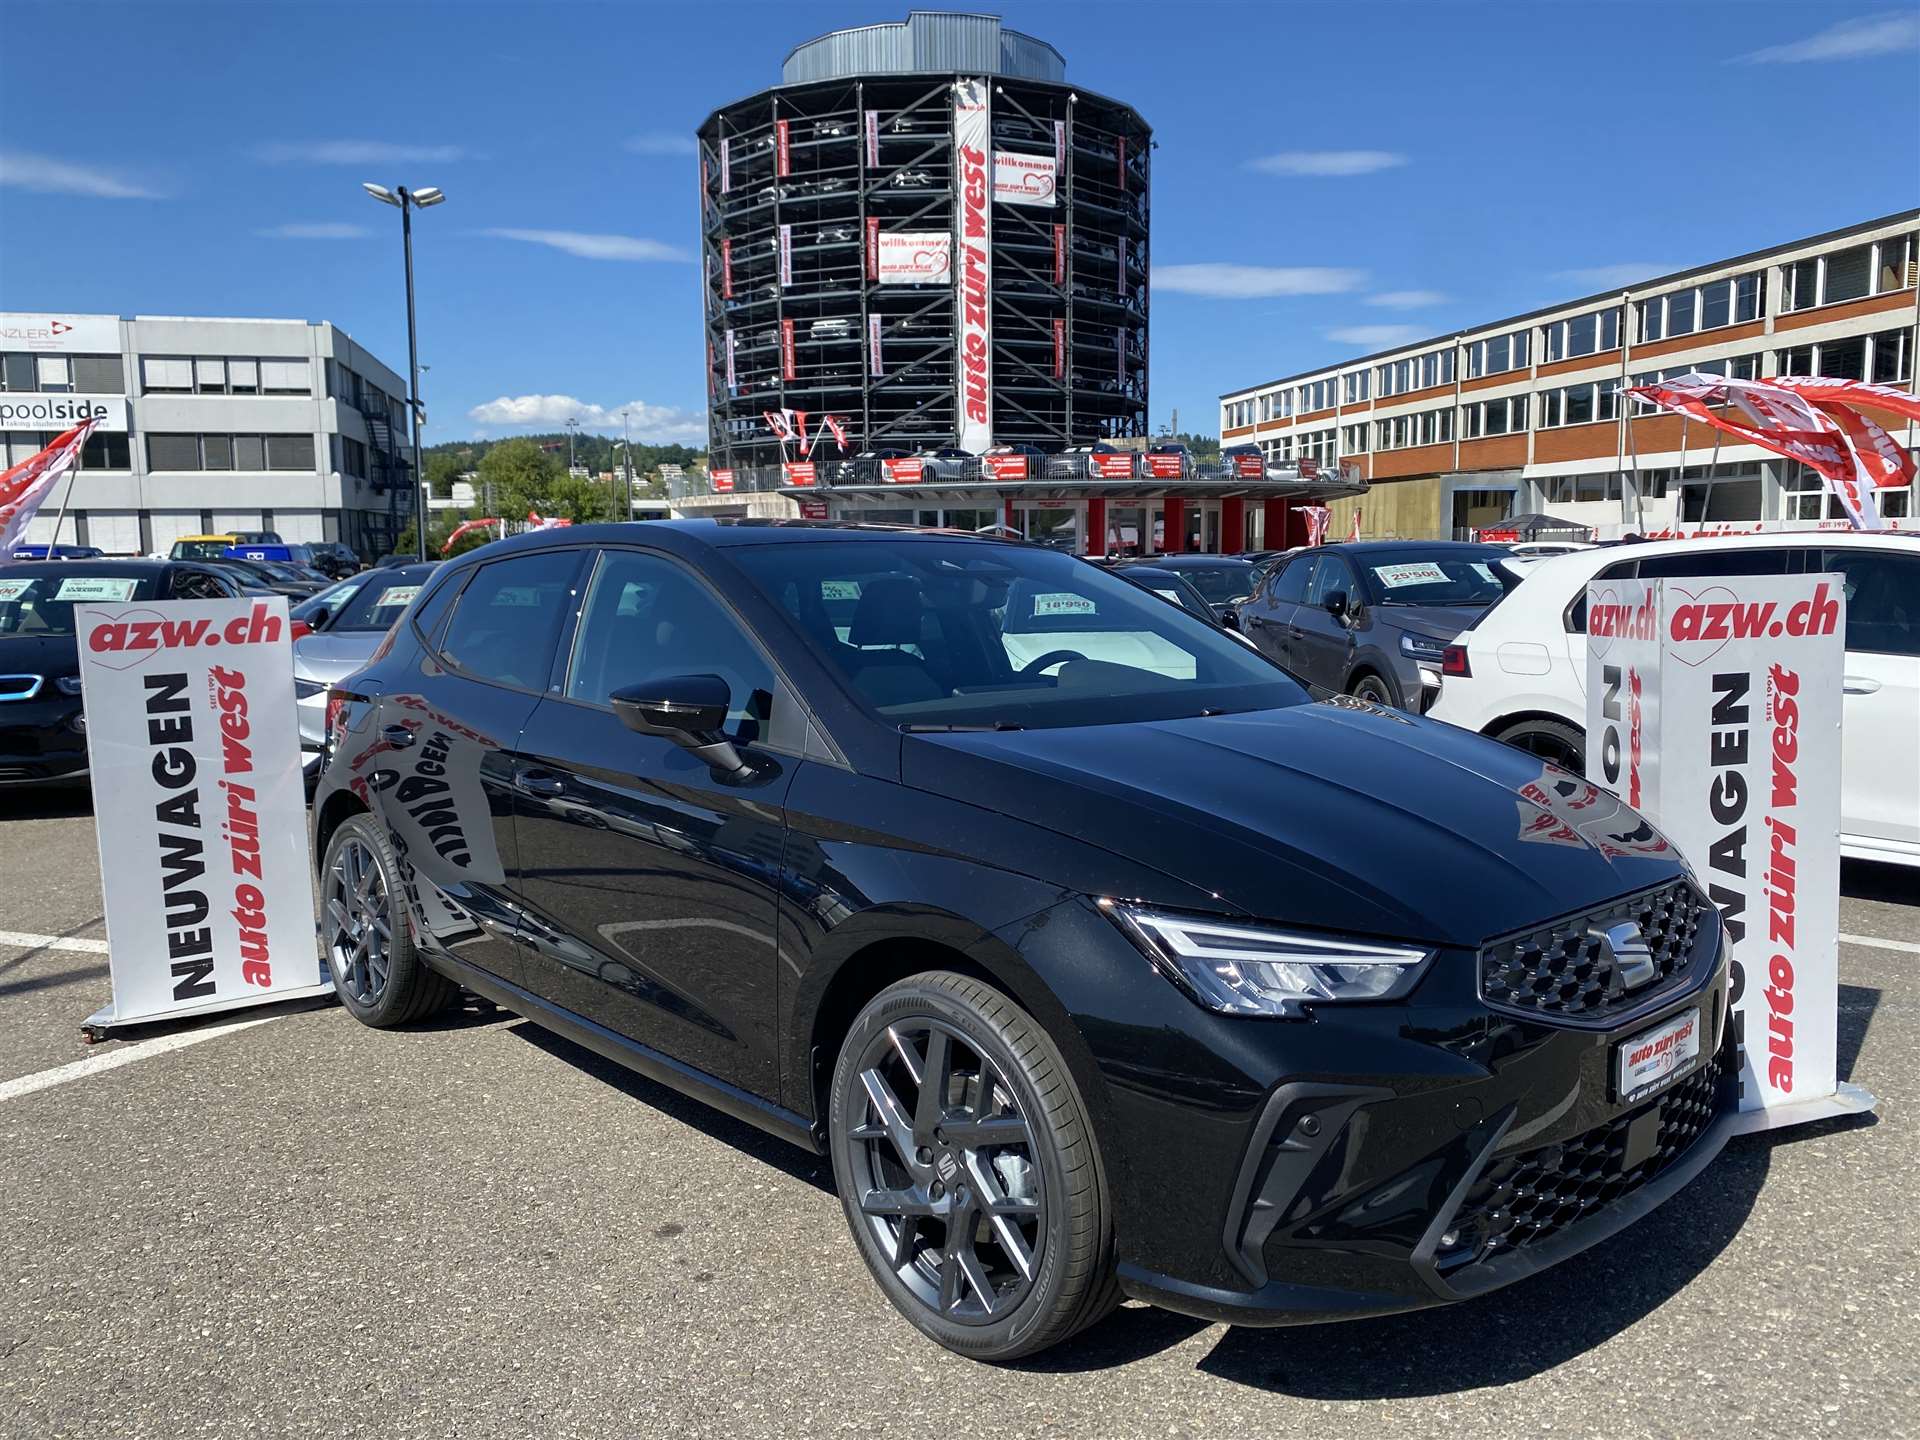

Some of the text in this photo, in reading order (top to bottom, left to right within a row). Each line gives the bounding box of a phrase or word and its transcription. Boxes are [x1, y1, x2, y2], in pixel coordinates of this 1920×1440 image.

[992, 156, 1054, 171] willkommen
[880, 238, 948, 248] willkommen
[960, 144, 987, 425] auto züri west
[0, 400, 108, 427] poolside
[1392, 570, 1440, 581] 25'500
[89, 603, 282, 652] azw.ch
[1589, 588, 1656, 641] azw.ch
[1670, 583, 1840, 642] azw.ch
[144, 673, 217, 1002] NEUWAGEN
[208, 665, 272, 988] auto züri west
[1763, 662, 1800, 1095] auto züri west
[1628, 1044, 1654, 1068] auto
[1674, 1021, 1695, 1044] west
